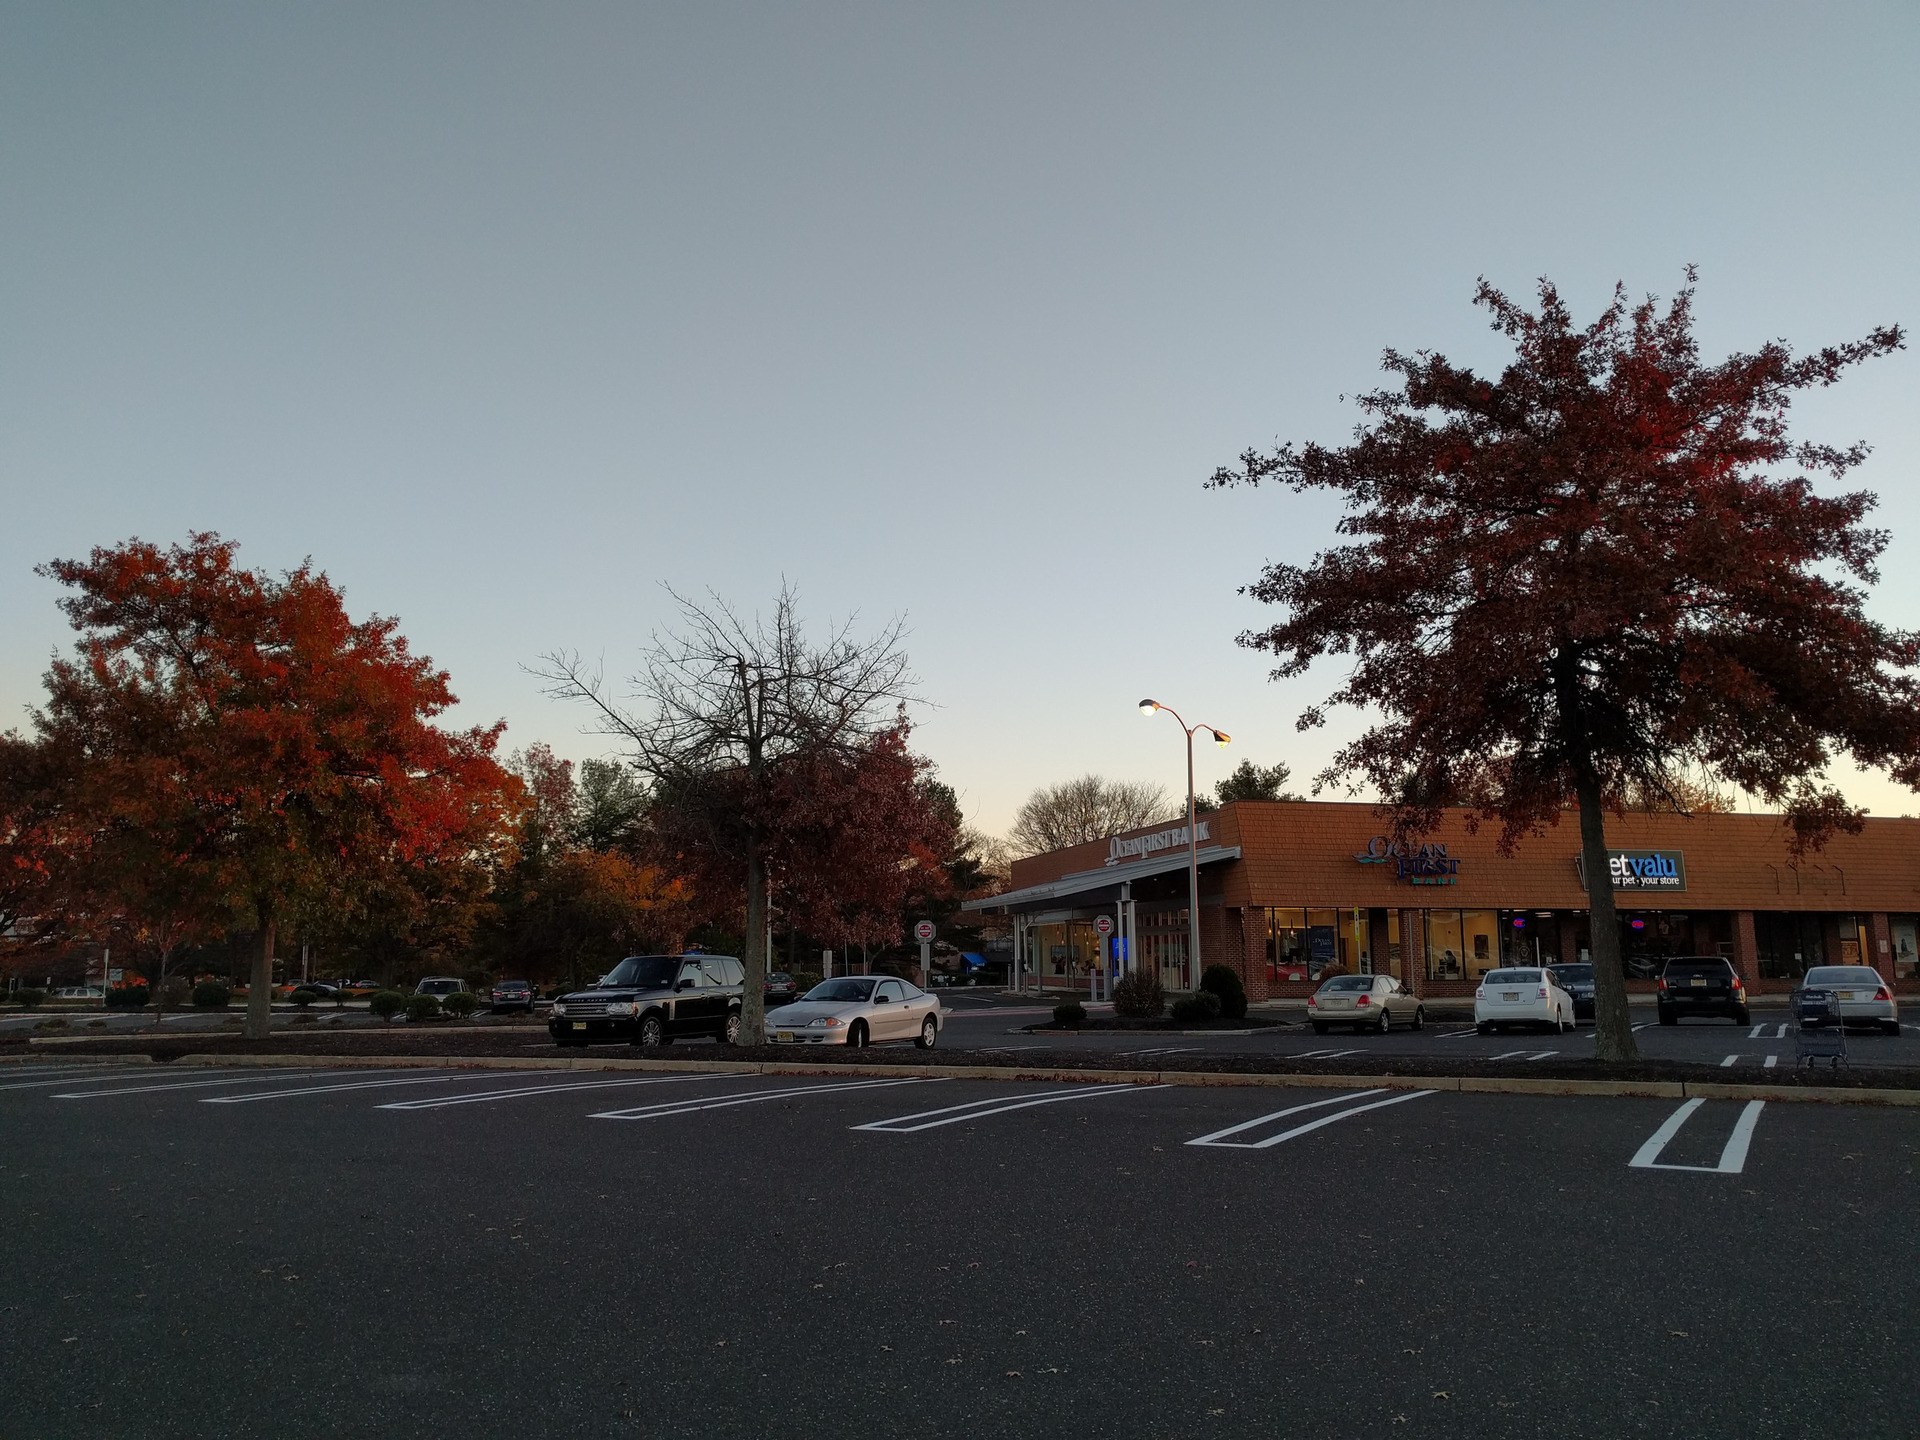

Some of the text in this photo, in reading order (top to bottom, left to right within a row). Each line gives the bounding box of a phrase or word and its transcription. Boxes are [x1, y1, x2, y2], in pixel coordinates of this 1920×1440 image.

[1609, 853, 1677, 876] etvalu
[1622, 877, 1635, 887] pet
[1641, 877, 1659, 887] your
[1660, 877, 1680, 885] store
